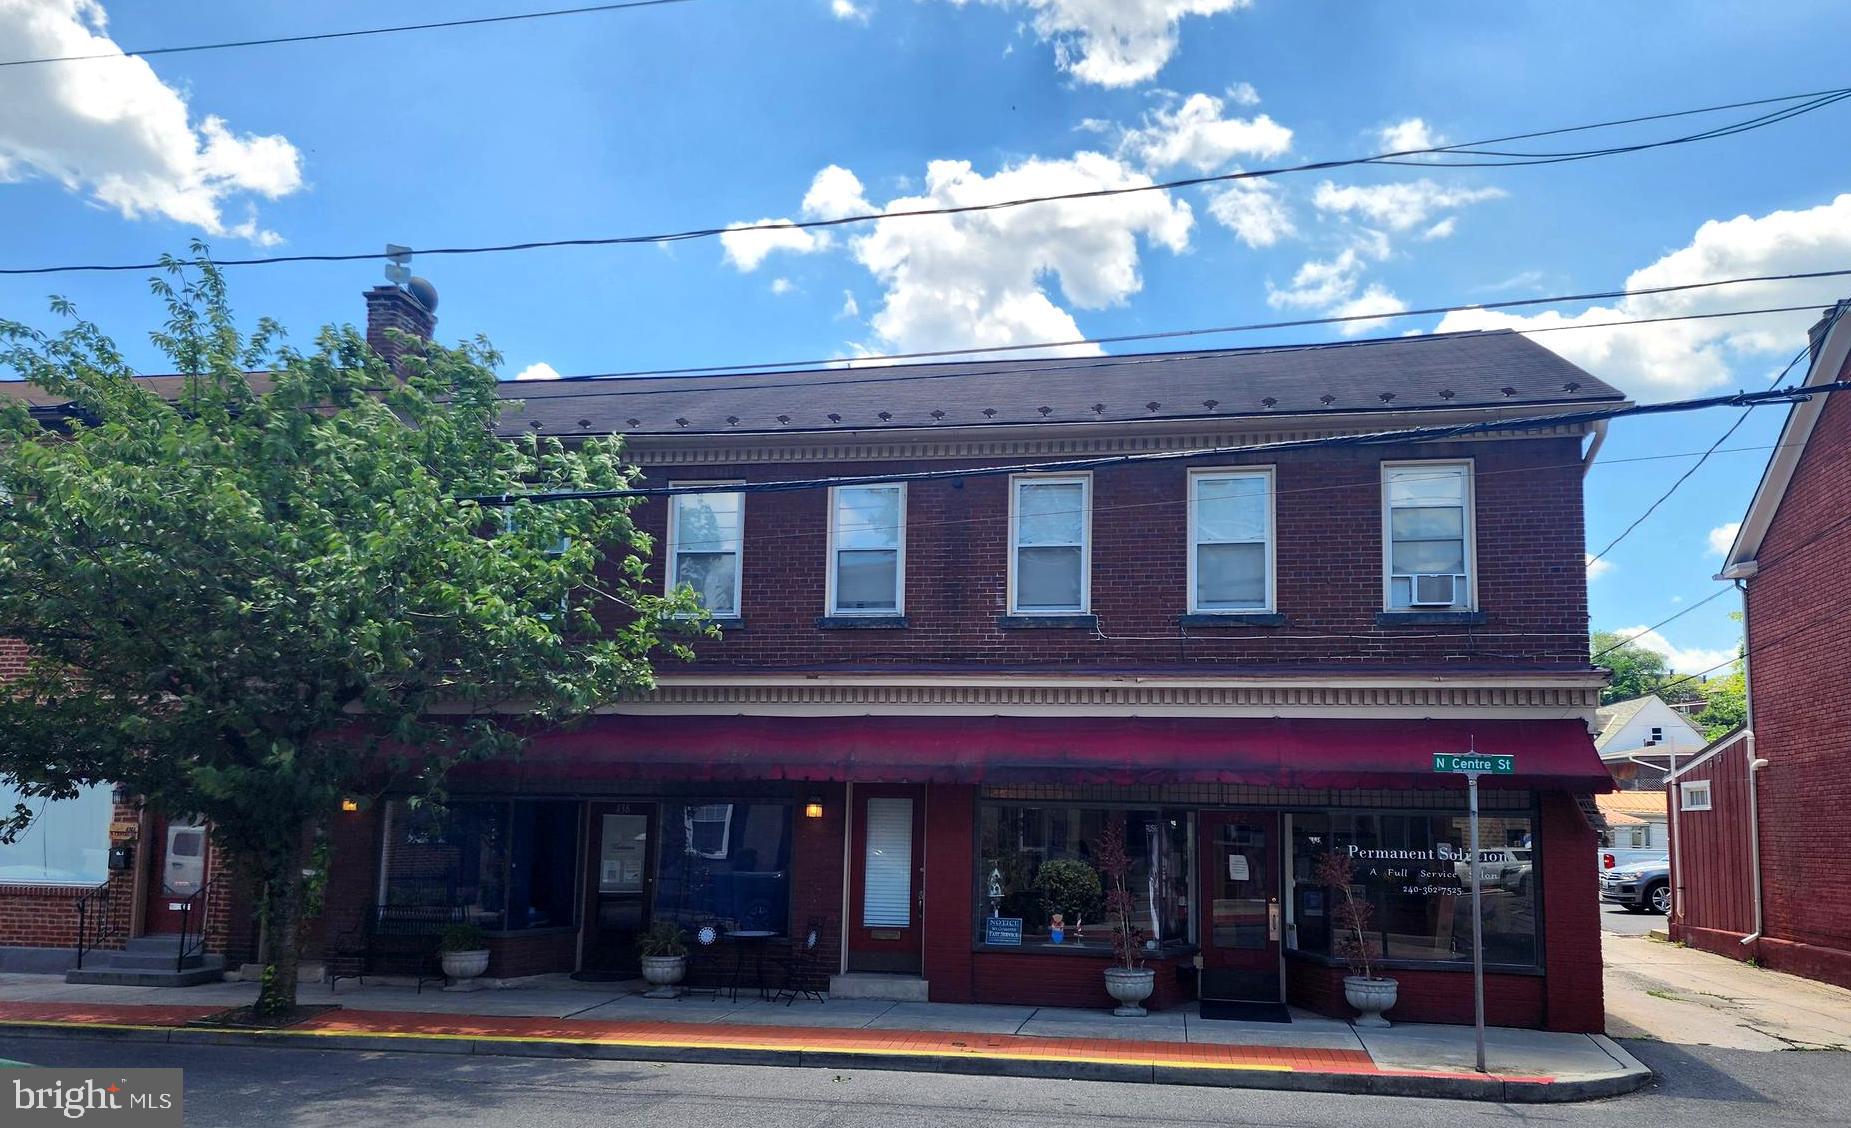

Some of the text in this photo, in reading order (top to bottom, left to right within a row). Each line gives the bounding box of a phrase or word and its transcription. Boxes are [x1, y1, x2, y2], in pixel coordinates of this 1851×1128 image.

[1436, 757, 1511, 770] N Centre St
[1348, 844, 1509, 862] Permanent Soluion
[1369, 867, 1498, 880] A Full Service lon
[1402, 884, 1462, 896] 240-362-7525
